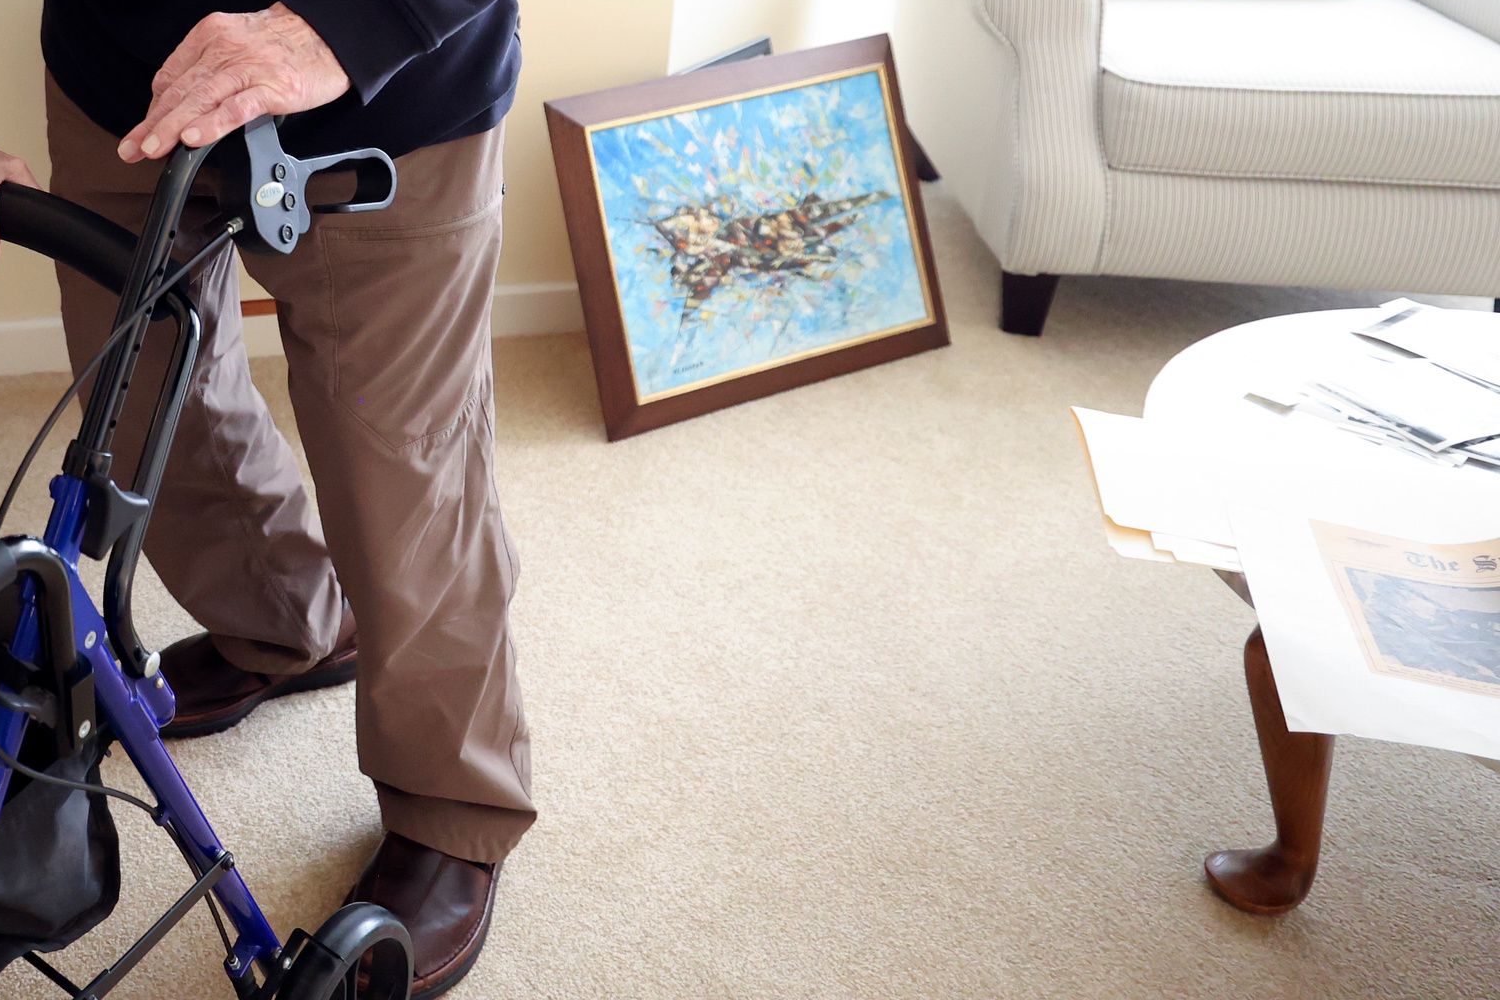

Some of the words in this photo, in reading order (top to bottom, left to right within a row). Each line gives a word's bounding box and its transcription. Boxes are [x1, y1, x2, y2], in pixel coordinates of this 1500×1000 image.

[260, 187, 281, 199] drive
[1404, 551, 1460, 571] The
[1472, 555, 1500, 573] S
